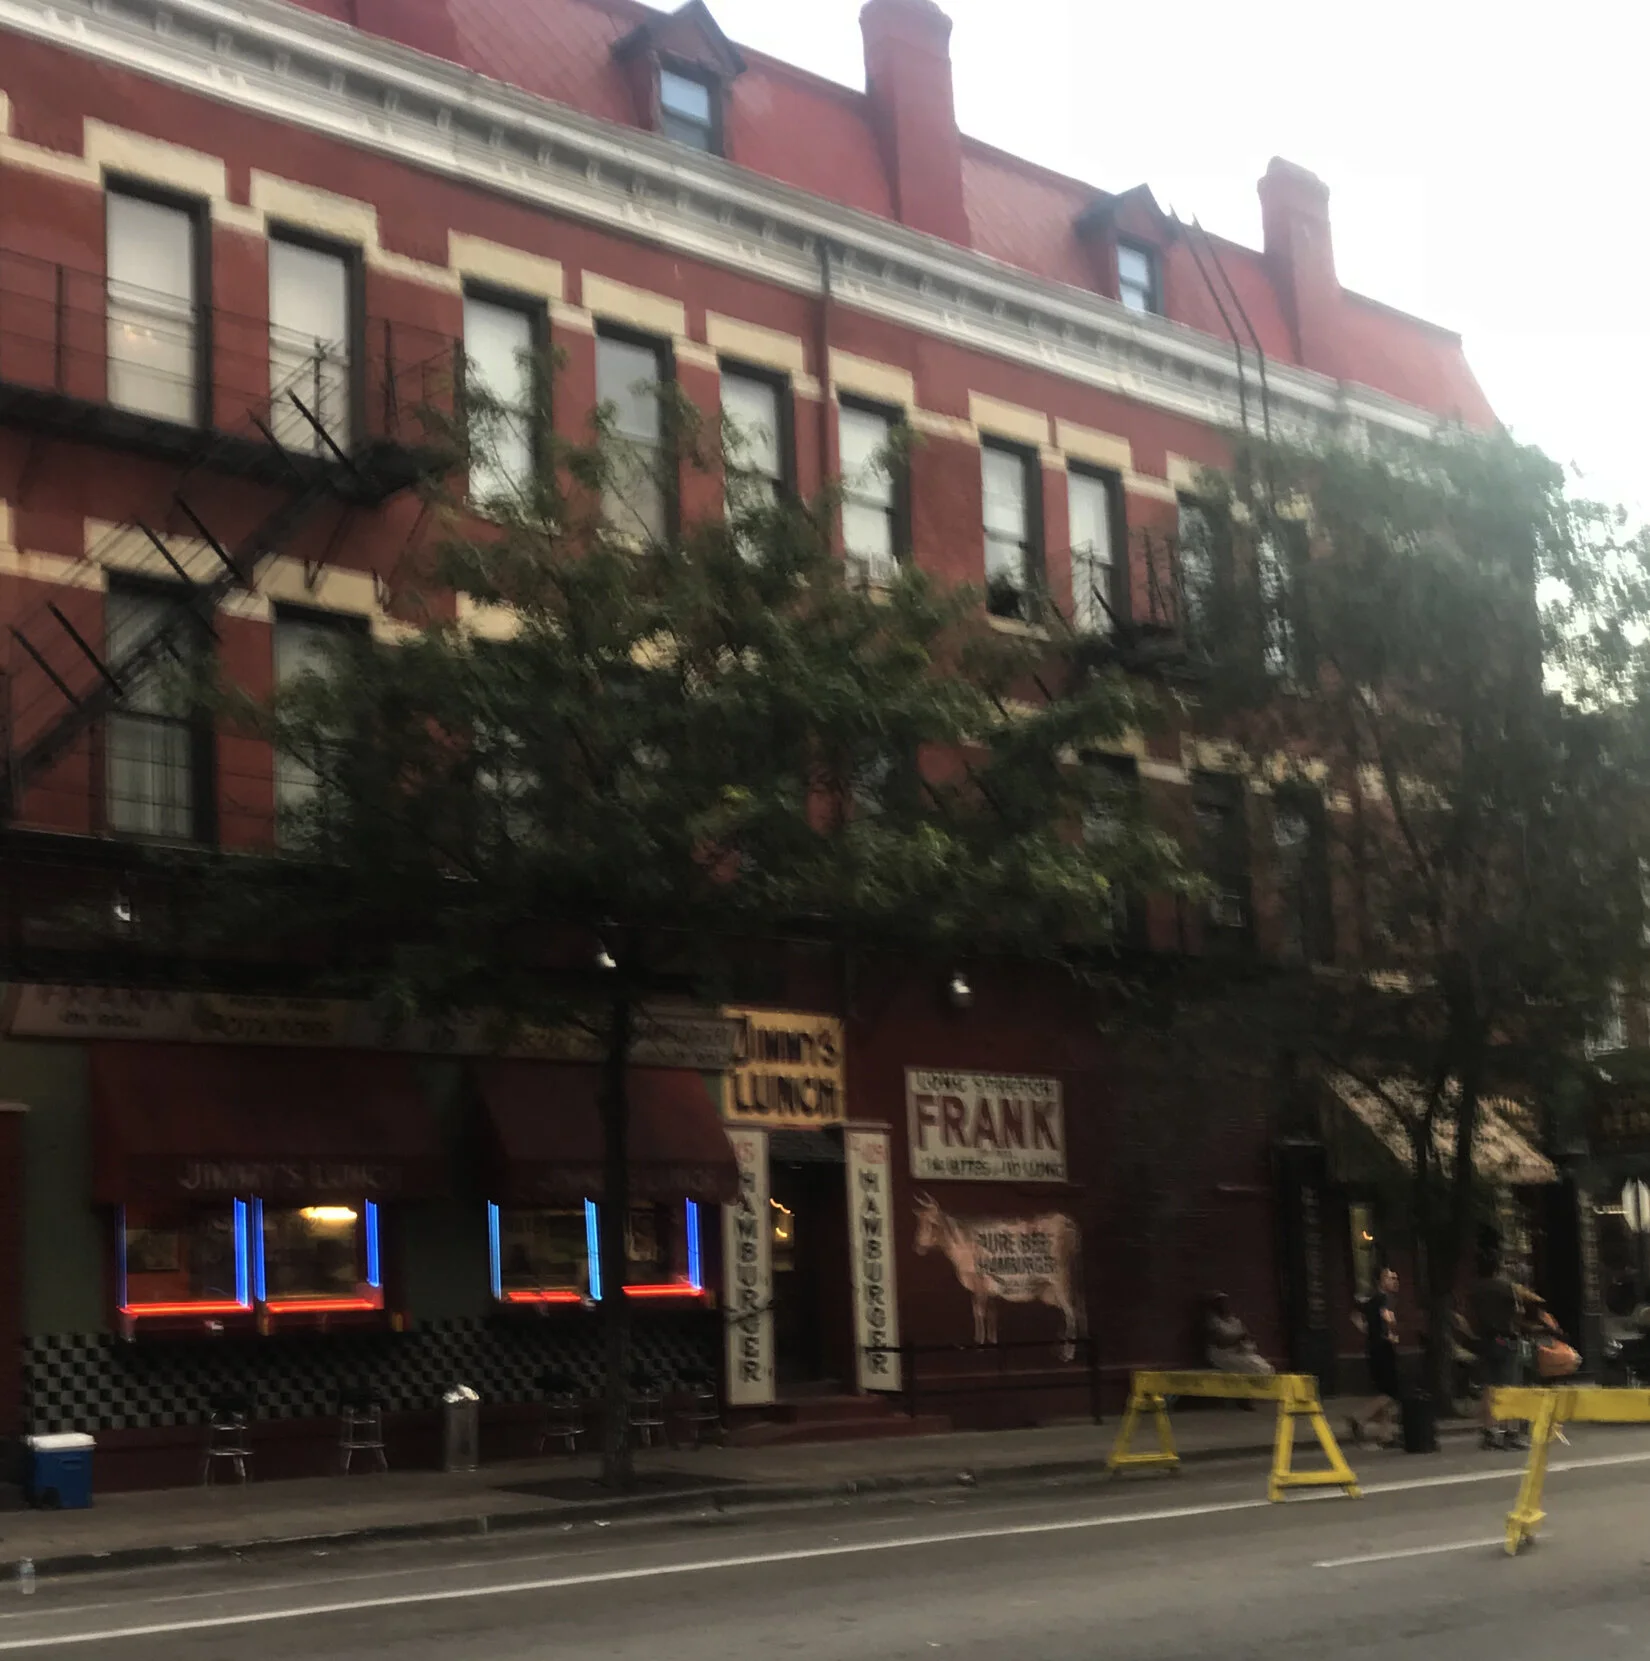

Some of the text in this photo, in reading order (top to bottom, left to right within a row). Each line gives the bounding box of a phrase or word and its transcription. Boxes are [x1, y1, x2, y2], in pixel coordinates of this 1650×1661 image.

[731, 1072, 838, 1118] LUNCH
[915, 1094, 1060, 1150] FRANK
[733, 1171, 762, 1383] HAMBURGER
[859, 1168, 889, 1375] HAMBURGER
